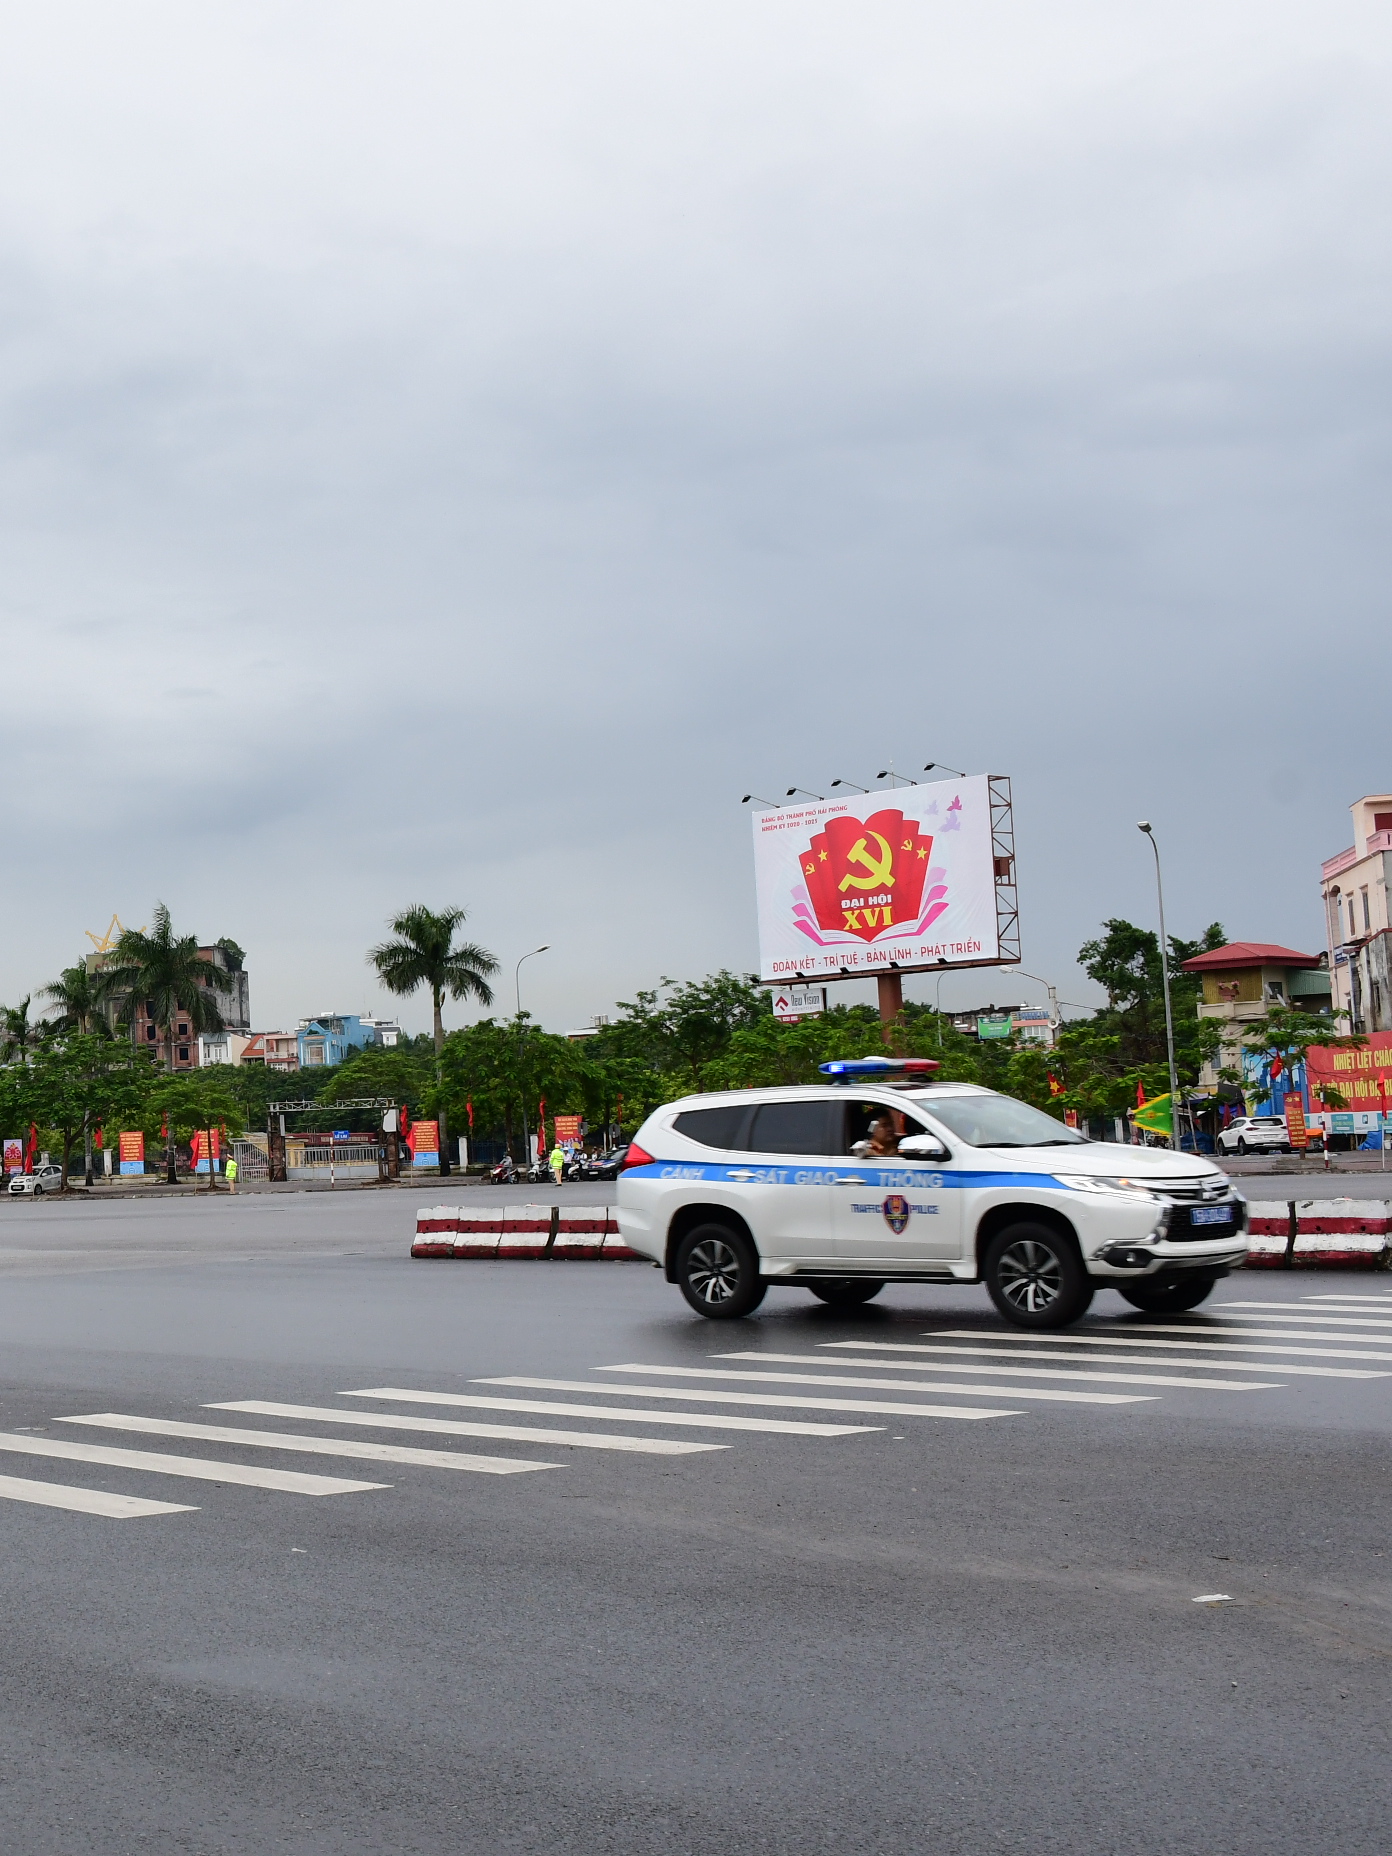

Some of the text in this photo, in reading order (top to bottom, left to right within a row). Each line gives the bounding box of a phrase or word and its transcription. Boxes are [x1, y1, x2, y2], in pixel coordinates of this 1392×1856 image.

[841, 894, 892, 909] ĐẠI HỘI
[841, 906, 894, 930] XVI
[773, 960, 798, 973] ĐOÀN
[799, 956, 816, 970] KẾT
[824, 953, 839, 967] TRÍ
[841, 951, 858, 967] TUỆ
[866, 948, 887, 963] BẢN
[889, 946, 912, 960] LĨNH
[920, 942, 946, 958] PHÁT
[950, 936, 982, 954] TRIỂN
[1333, 1050, 1355, 1074] NHIỆT
[1356, 1048, 1372, 1072] LIỆT
[1354, 1078, 1368, 1102] HỘI
[660, 1164, 944, 1188] CẢNH SÁT GIAO THÔNG
[850, 1204, 940, 1214] TRAFFIC POLICE
